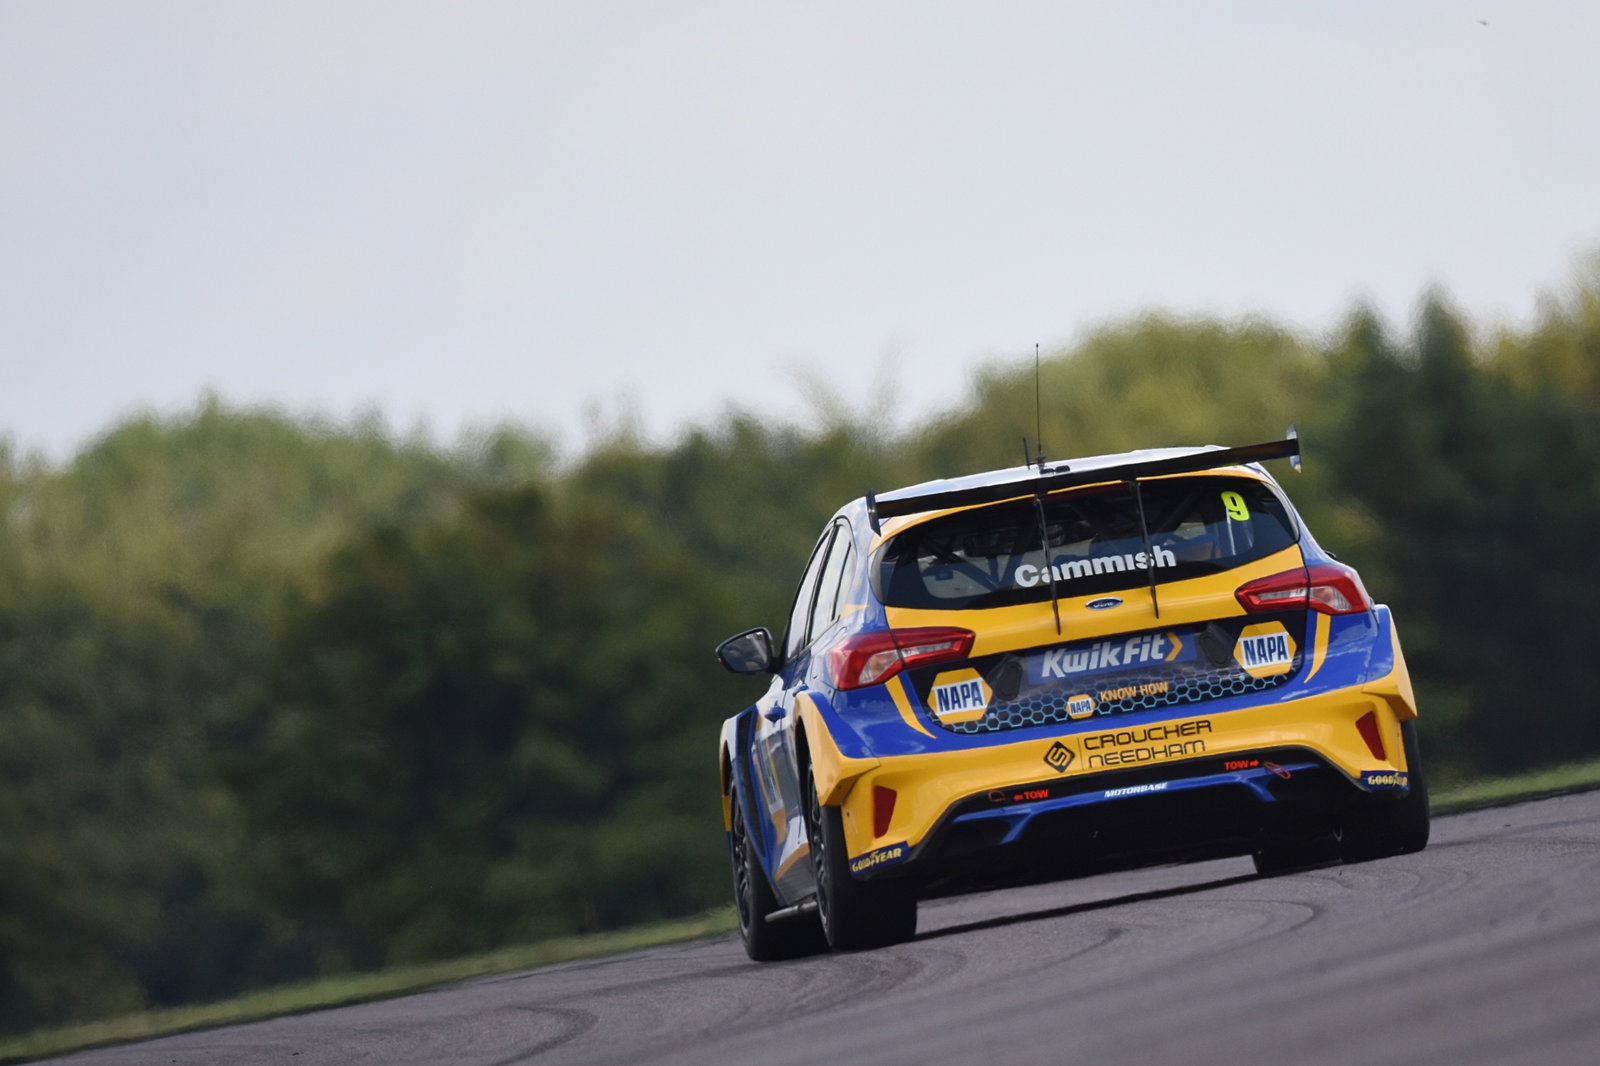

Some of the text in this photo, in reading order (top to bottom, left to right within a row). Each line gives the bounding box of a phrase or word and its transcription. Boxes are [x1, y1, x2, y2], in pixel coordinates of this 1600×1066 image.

[1221, 491, 1249, 521] 9
[1014, 545, 1176, 588] Cammish
[1243, 635, 1289, 666] NAPA
[937, 682, 983, 712] NAPA
[1070, 682, 1169, 713] NAPA KNOW HOW
[1084, 720, 1212, 750] CROUCHER
[1088, 740, 1205, 768] NEEDHAM
[1224, 760, 1249, 771] TOW
[1024, 790, 1049, 800] TOW
[1104, 782, 1168, 798] MOTORBASE
